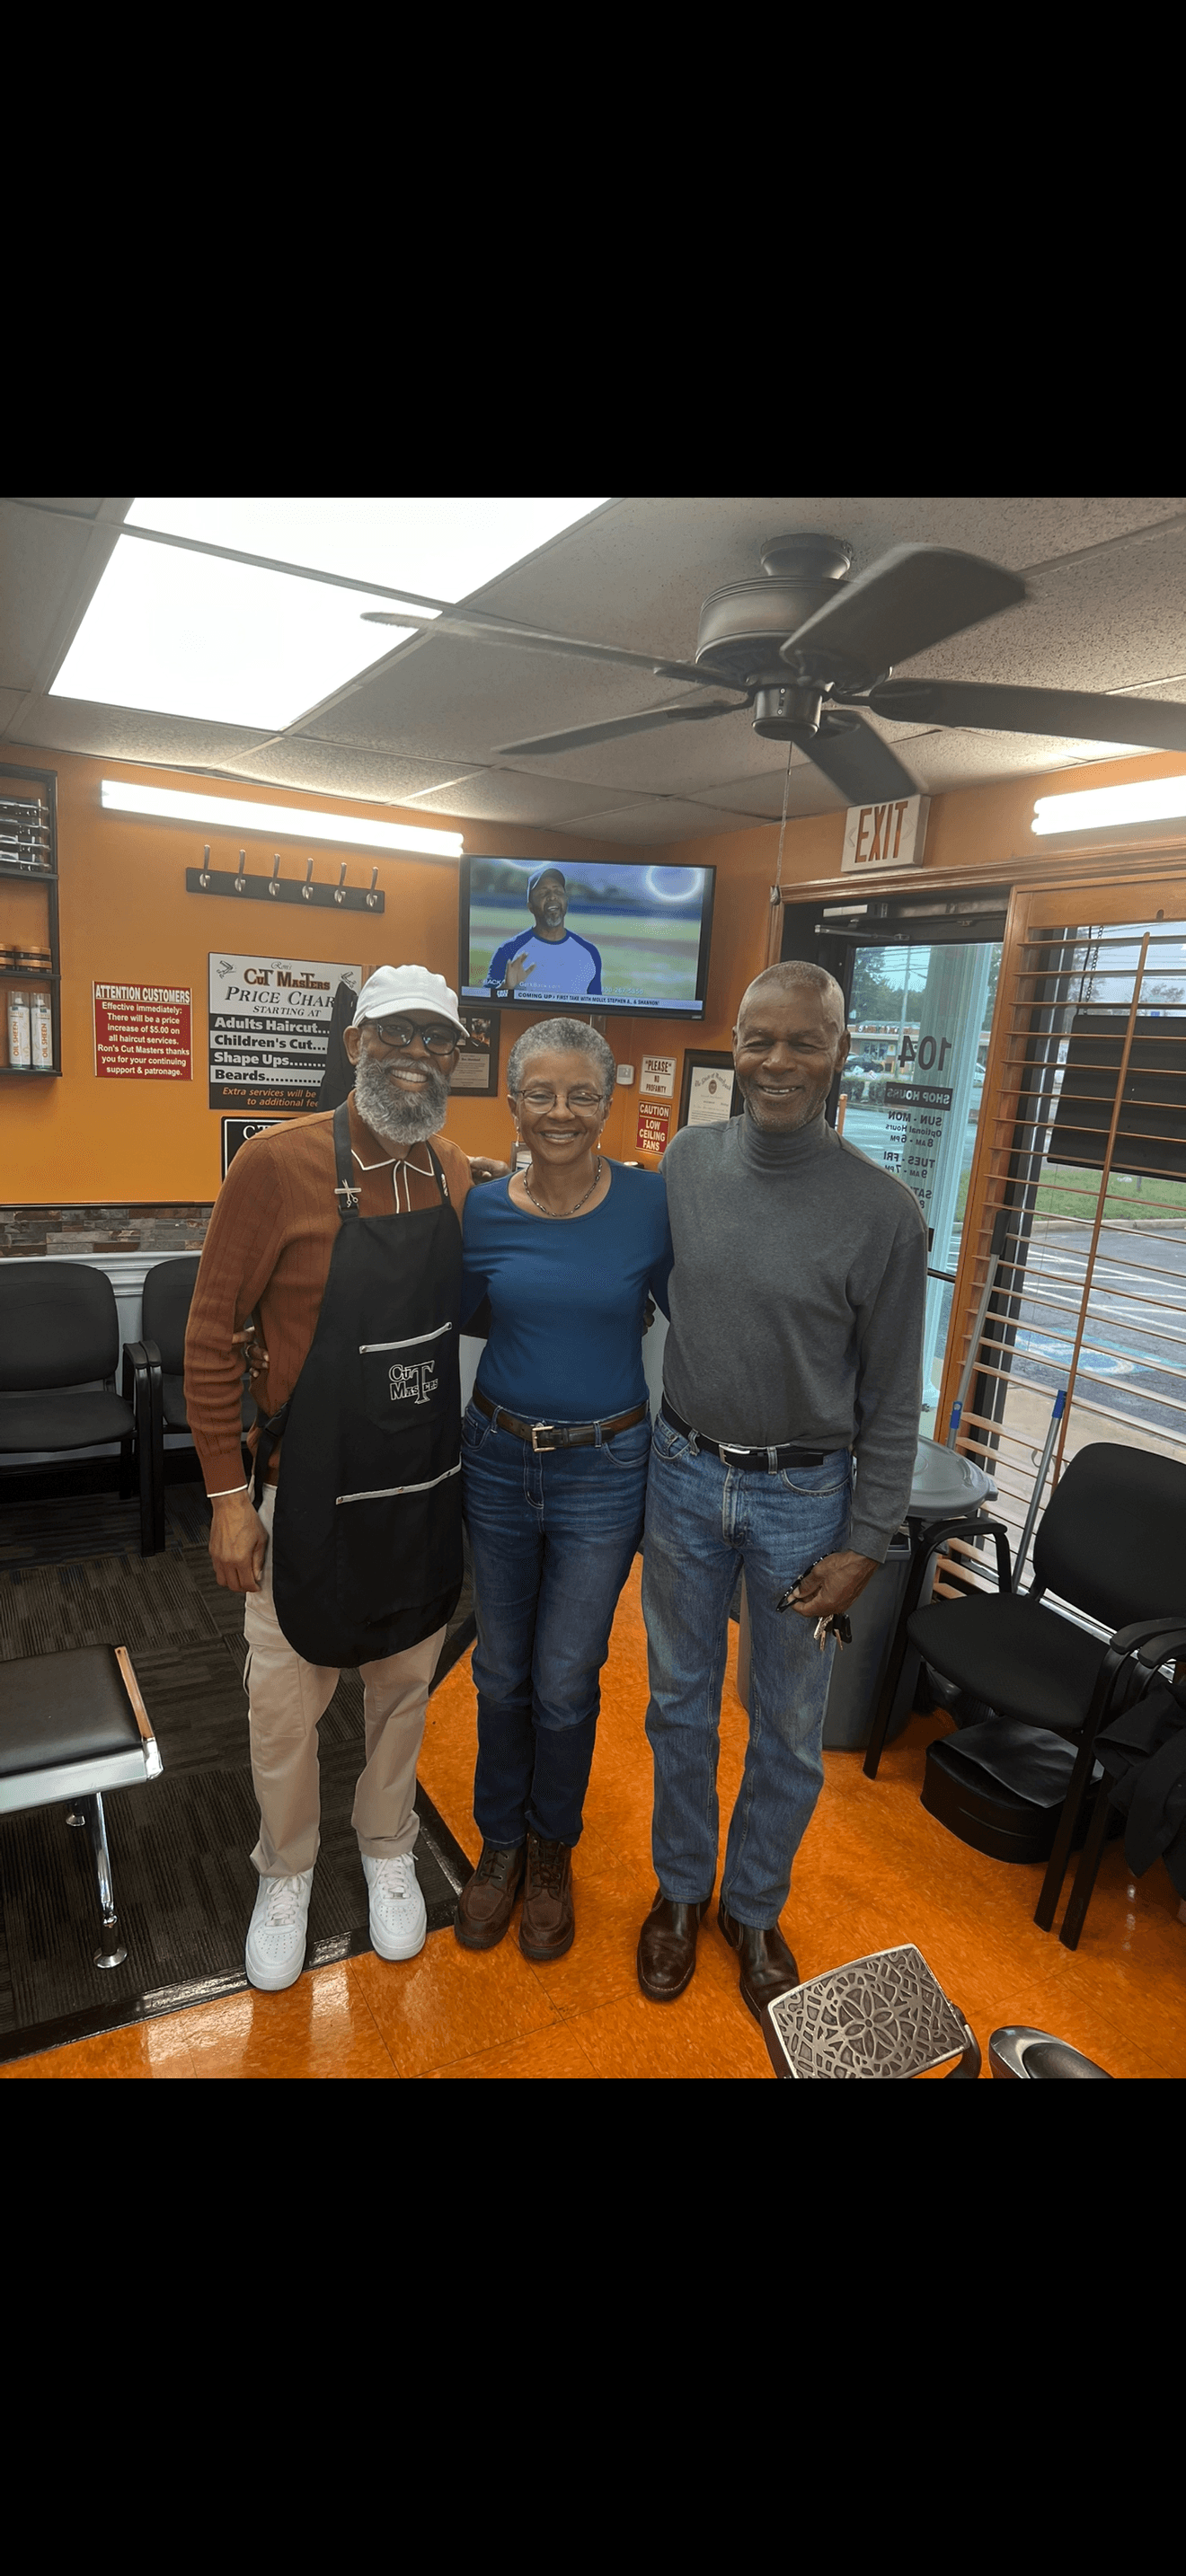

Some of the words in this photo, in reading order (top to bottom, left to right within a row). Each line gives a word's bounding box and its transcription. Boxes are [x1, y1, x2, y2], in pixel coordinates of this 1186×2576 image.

[854, 800, 908, 863] EXIT
[270, 961, 292, 970] Ron's
[95, 984, 141, 1001] ATTENTION
[142, 987, 190, 1004] CUSTOMERS
[225, 986, 280, 1004] PRICE
[288, 991, 335, 1008] CHAR
[102, 1001, 135, 1011] Effective
[252, 1005, 305, 1017] STARTING
[307, 1010, 322, 1018] AT
[107, 1012, 128, 1021] There
[130, 1014, 144, 1022] will
[145, 1015, 154, 1023] be
[162, 1017, 180, 1025] price
[215, 1017, 263, 1030] Adults
[140, 1025, 148, 1033] of
[149, 1025, 169, 1034] $5.00
[109, 1034, 118, 1042] all
[119, 1035, 146, 1044] haircut
[146, 1037, 180, 1045] services.
[214, 1035, 287, 1048] Children's
[97, 1044, 119, 1053] Ron's
[120, 1045, 135, 1054] Cut
[135, 1045, 164, 1054] Masters
[165, 1047, 190, 1055] thanks
[102, 1055, 116, 1063] you
[117, 1054, 128, 1063] for
[148, 1057, 187, 1067] continuing
[214, 1052, 260, 1066] Shape
[106, 1066, 136, 1075] support
[137, 1066, 143, 1074] &
[145, 1068, 183, 1077] patronage.
[654, 1075, 660, 1083] NO
[222, 1087, 246, 1096] Extra
[249, 1089, 284, 1097] services
[287, 1089, 303, 1098] will
[305, 1090, 316, 1098] be
[645, 1083, 667, 1094] PROFANITY
[247, 1098, 257, 1106] to
[259, 1098, 304, 1107] additional
[640, 1104, 669, 1117] CAUTION
[645, 1119, 660, 1131] LOW
[639, 1128, 666, 1142] CEILING
[642, 1140, 660, 1151] FANS
